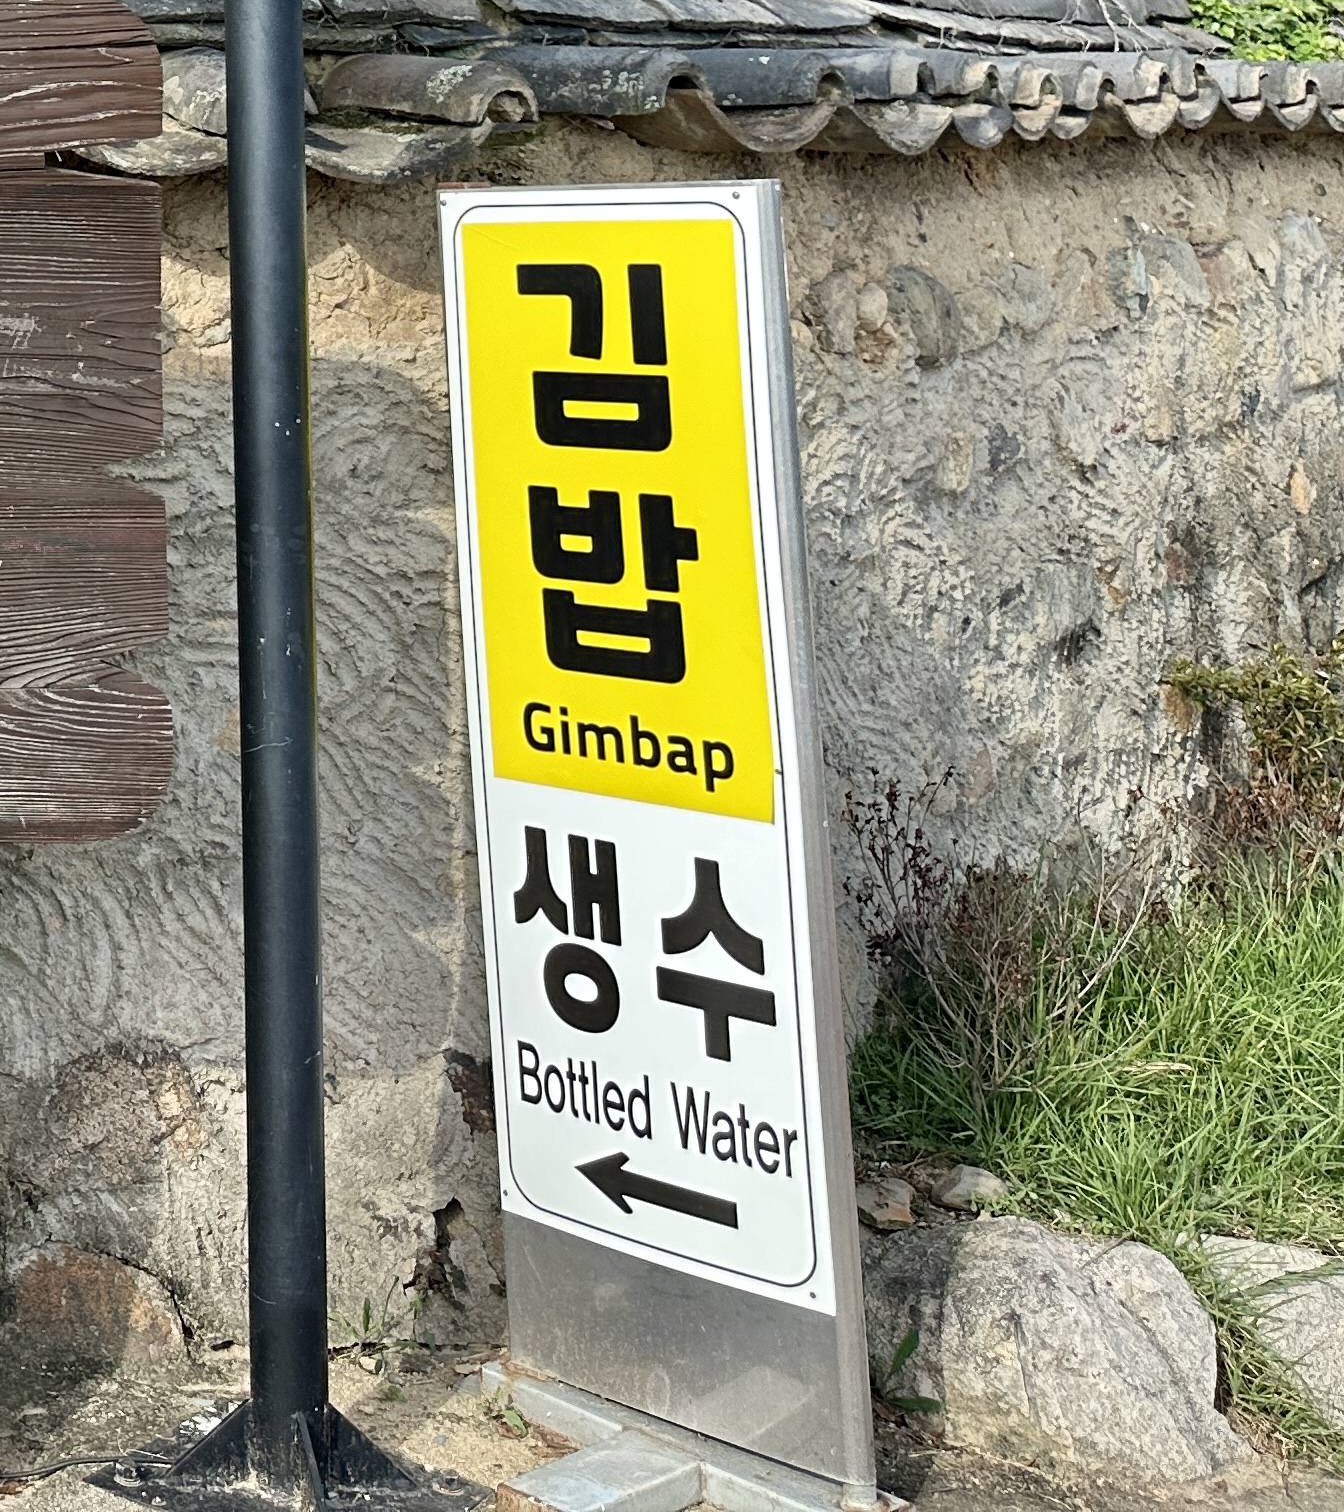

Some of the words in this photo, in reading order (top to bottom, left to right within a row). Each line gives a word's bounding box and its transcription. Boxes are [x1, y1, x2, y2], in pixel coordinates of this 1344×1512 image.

[516, 264, 699, 684] 김밥
[522, 702, 735, 793] Gimbap
[513, 826, 776, 1062] 생수
[517, 1040, 653, 1141] Bottled
[671, 1081, 797, 1178] Water
